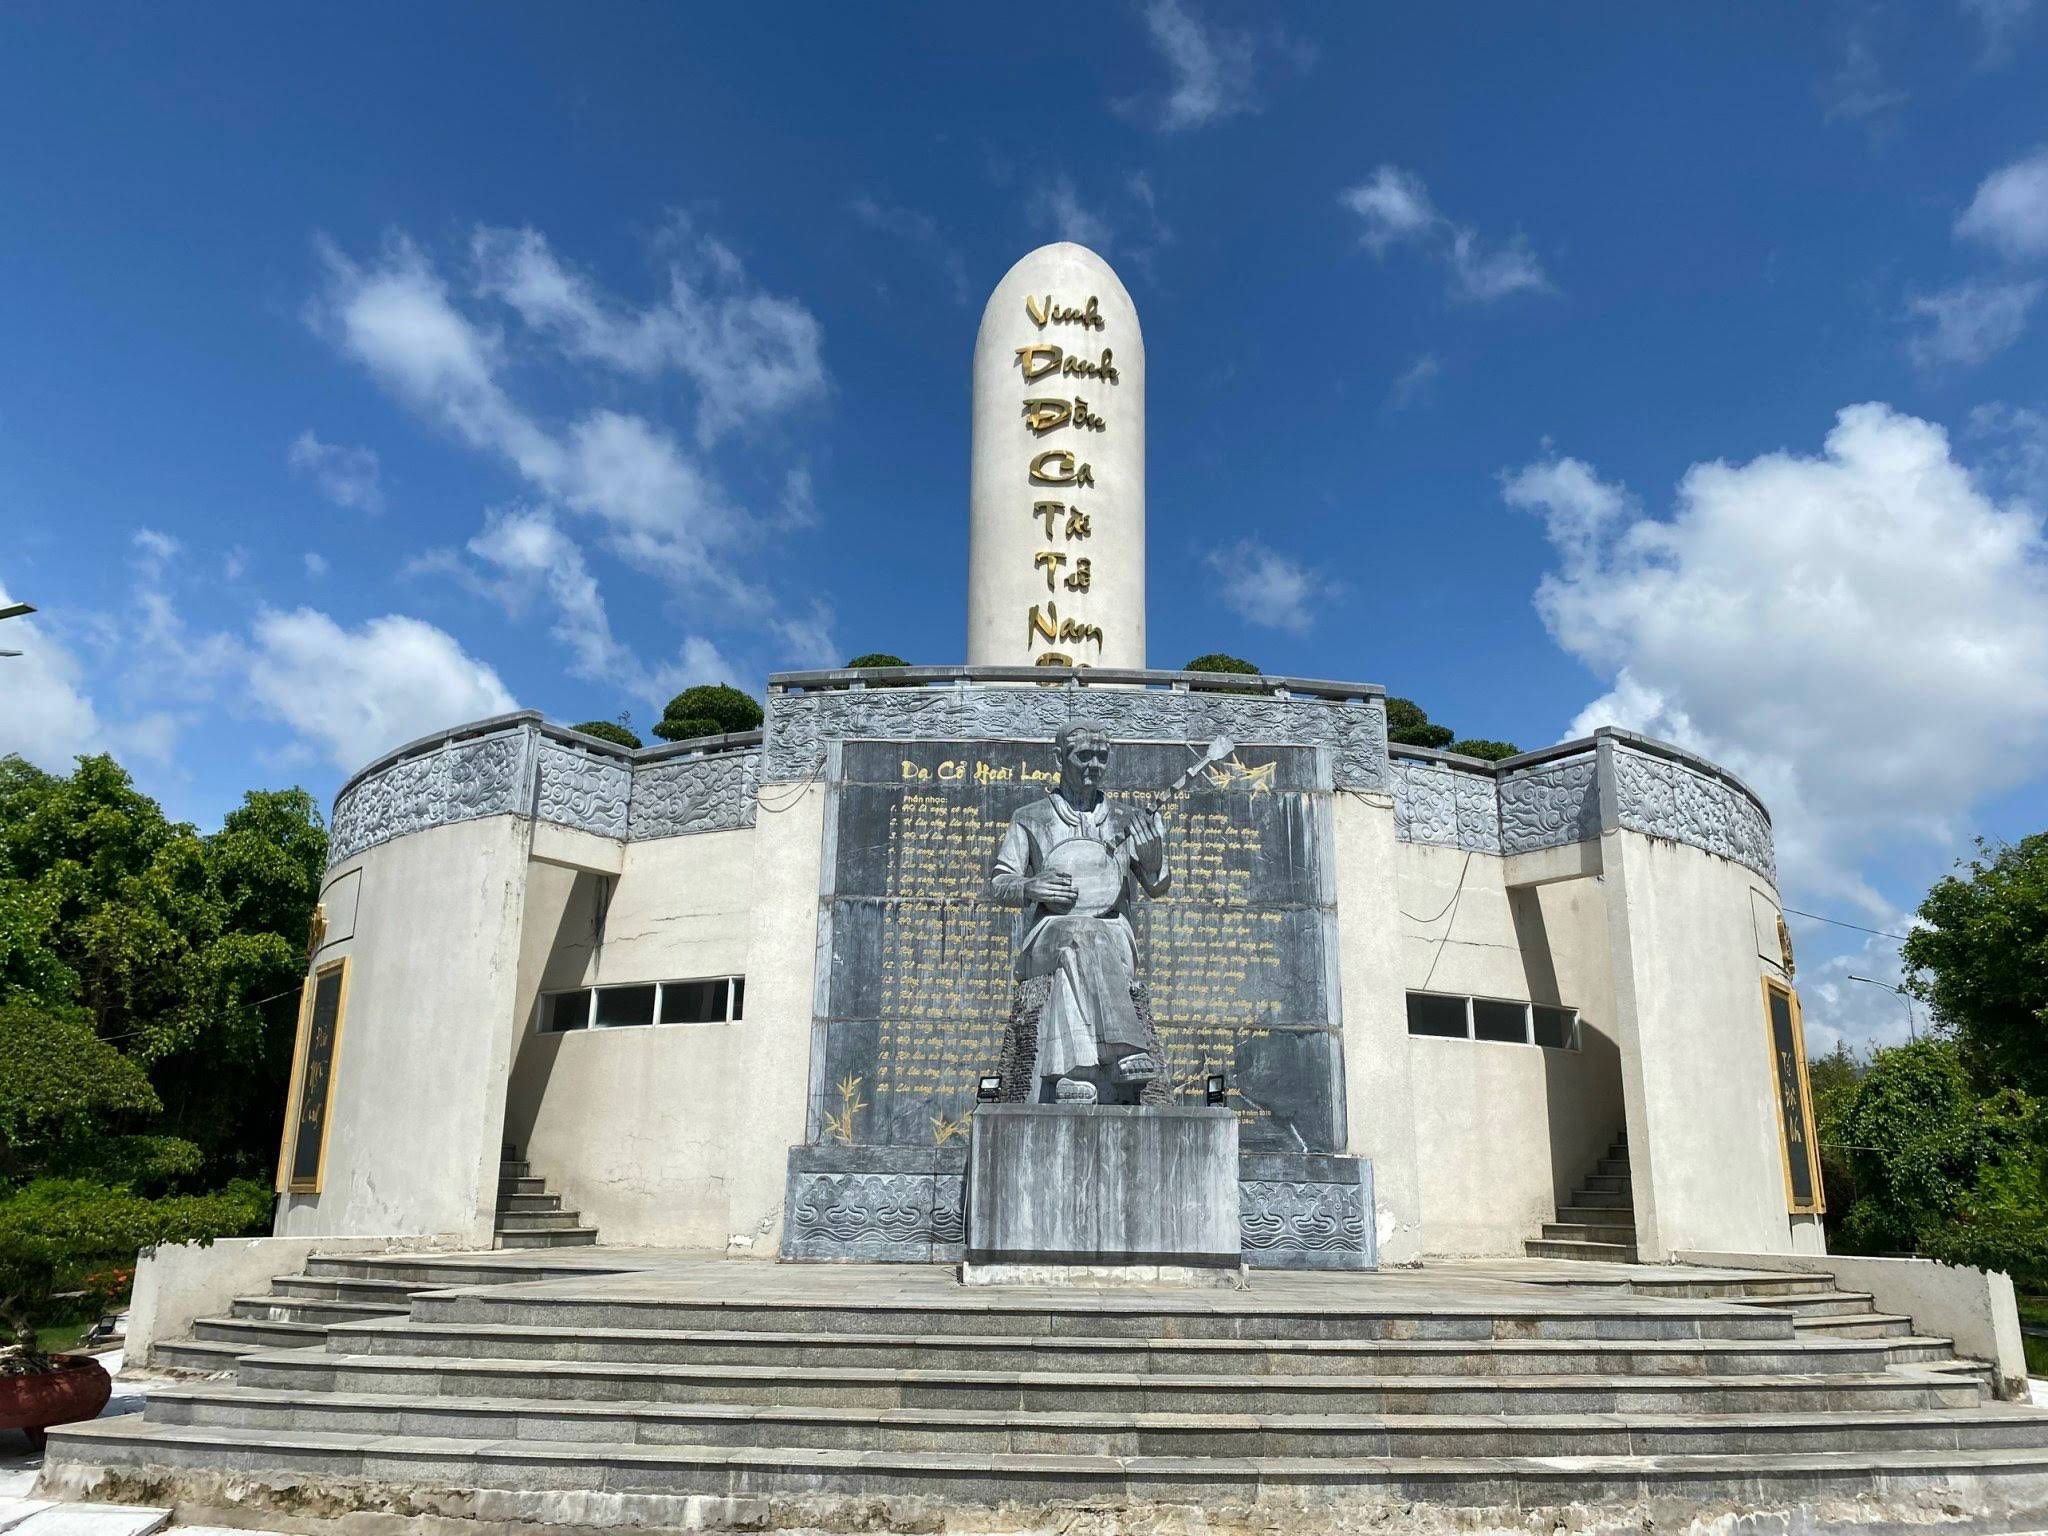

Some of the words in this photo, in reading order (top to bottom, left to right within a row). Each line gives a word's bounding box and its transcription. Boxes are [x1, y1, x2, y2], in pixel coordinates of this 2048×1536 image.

[1025, 294, 1105, 331] Vinh
[1014, 344, 1119, 386] Danh
[1023, 396, 1106, 433] Đờn
[1030, 449, 1095, 482] Ca
[1033, 501, 1092, 541] Tài
[1028, 602, 1103, 653] Nam
[937, 760, 968, 780] Cổ
[1132, 790, 1152, 799] Cao
